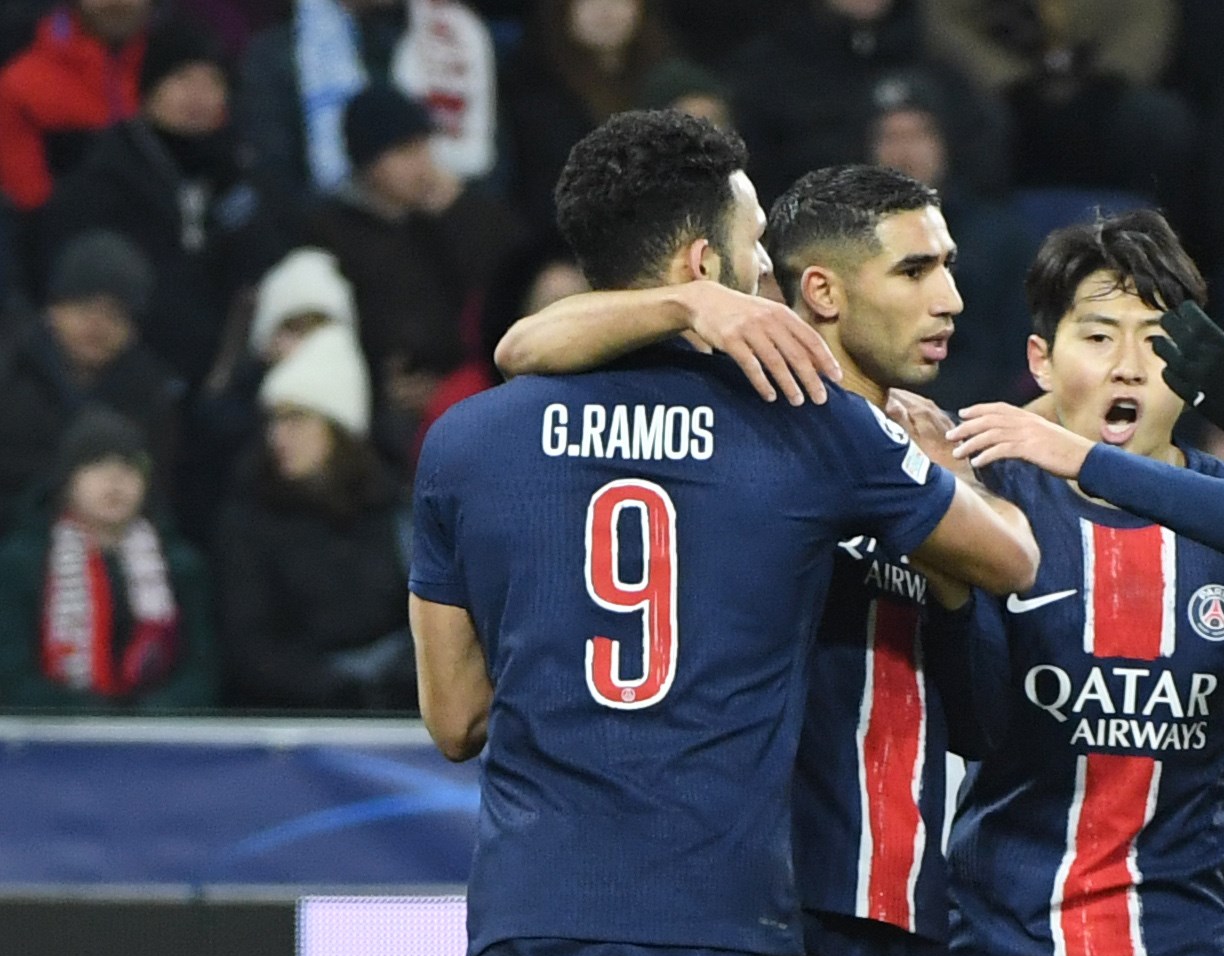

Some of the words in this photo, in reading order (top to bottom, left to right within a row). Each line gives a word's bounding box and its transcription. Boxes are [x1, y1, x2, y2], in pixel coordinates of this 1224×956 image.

[542, 403, 714, 460] G.RAMOS
[584, 478, 678, 710] 9
[864, 559, 927, 605] AIRW
[1024, 664, 1218, 723] QATAR
[1070, 717, 1208, 751] AIRWAYS
